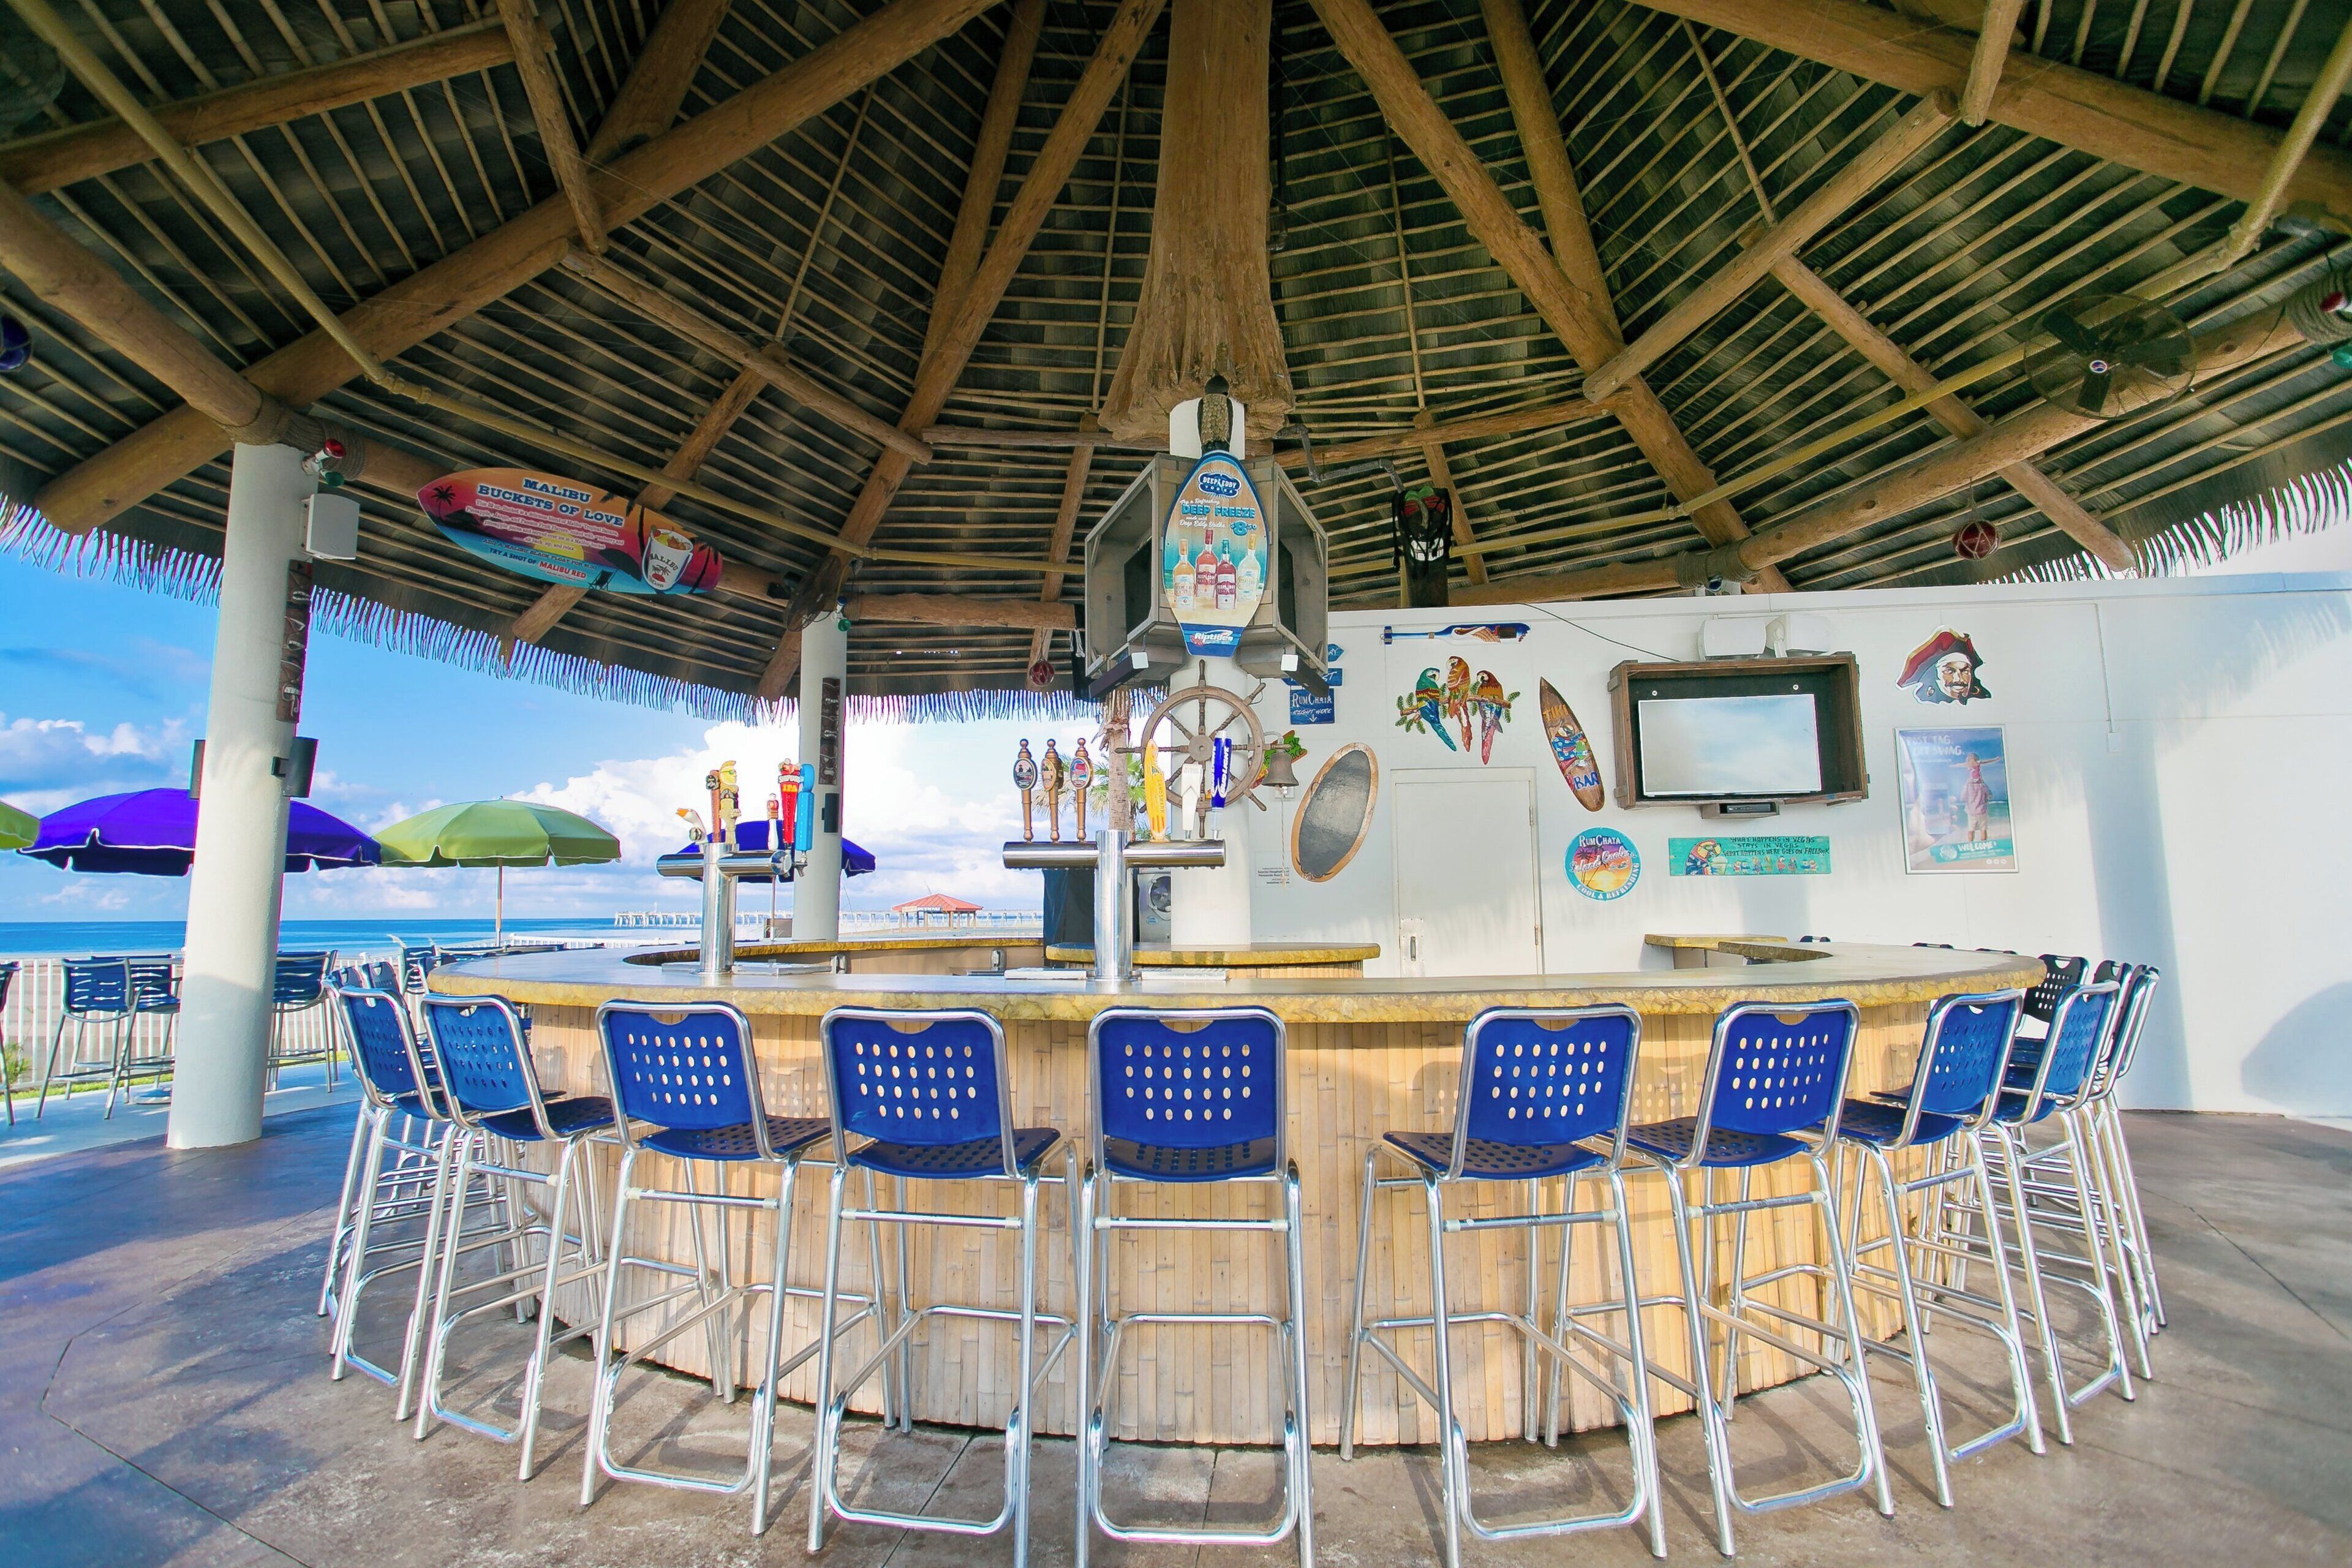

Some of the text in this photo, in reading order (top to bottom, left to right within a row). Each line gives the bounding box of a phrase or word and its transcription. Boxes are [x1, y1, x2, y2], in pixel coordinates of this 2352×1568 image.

[524, 479, 590, 502] MALIBU
[478, 485, 624, 526] BUCKETS OF LOVE
[1182, 503, 1256, 518] DEEP FREEZE
[508, 552, 527, 562] SHOT
[539, 561, 570, 574] MALIBU
[571, 569, 586, 578] RED
[1194, 632, 1234, 644] Riptides
[1543, 704, 1569, 722] TIKI
[1574, 771, 1600, 790] BAR
[1569, 846, 1637, 872] Island Coolers
[1577, 884, 1596, 898] COOL
[1606, 862, 1640, 899] REFRESHING
